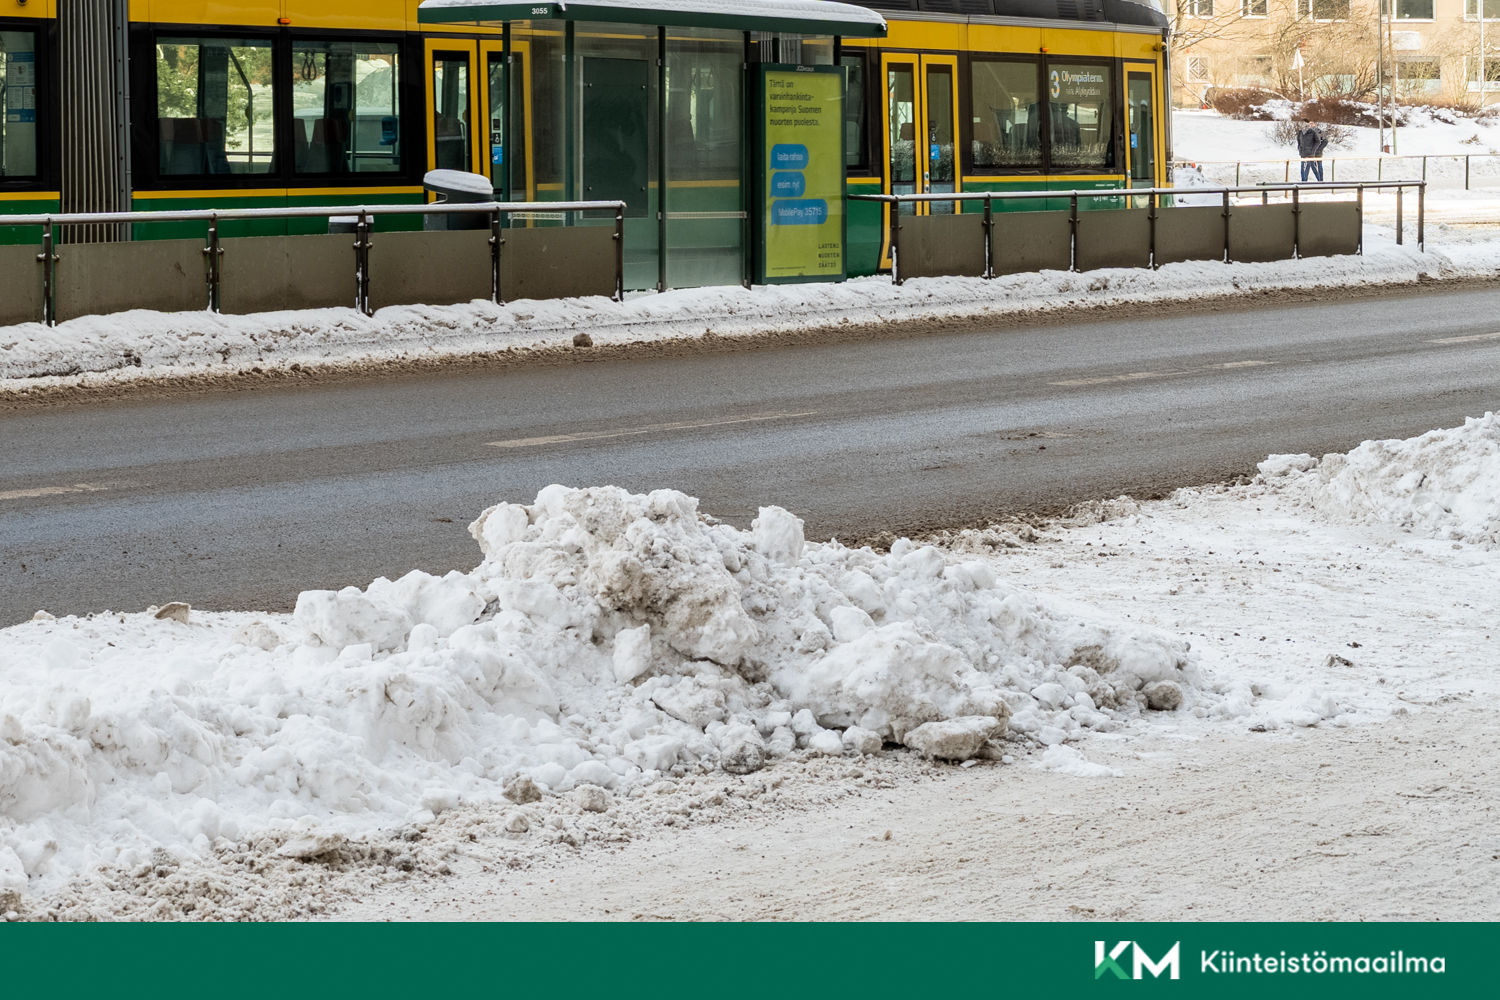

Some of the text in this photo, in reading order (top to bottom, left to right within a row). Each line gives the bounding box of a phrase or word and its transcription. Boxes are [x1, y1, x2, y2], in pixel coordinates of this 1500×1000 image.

[1061, 70, 1104, 85] Olympiaterm.
[769, 79, 784, 88] Tämä
[1051, 70, 1060, 98] 3
[769, 92, 814, 101] varainhankinta-
[769, 105, 821, 115] kampanja Suomen
[770, 118, 792, 126] nuorten
[778, 207, 822, 217] MobilePay 35715
[818, 260, 837, 268] SÄÄTIÖ
